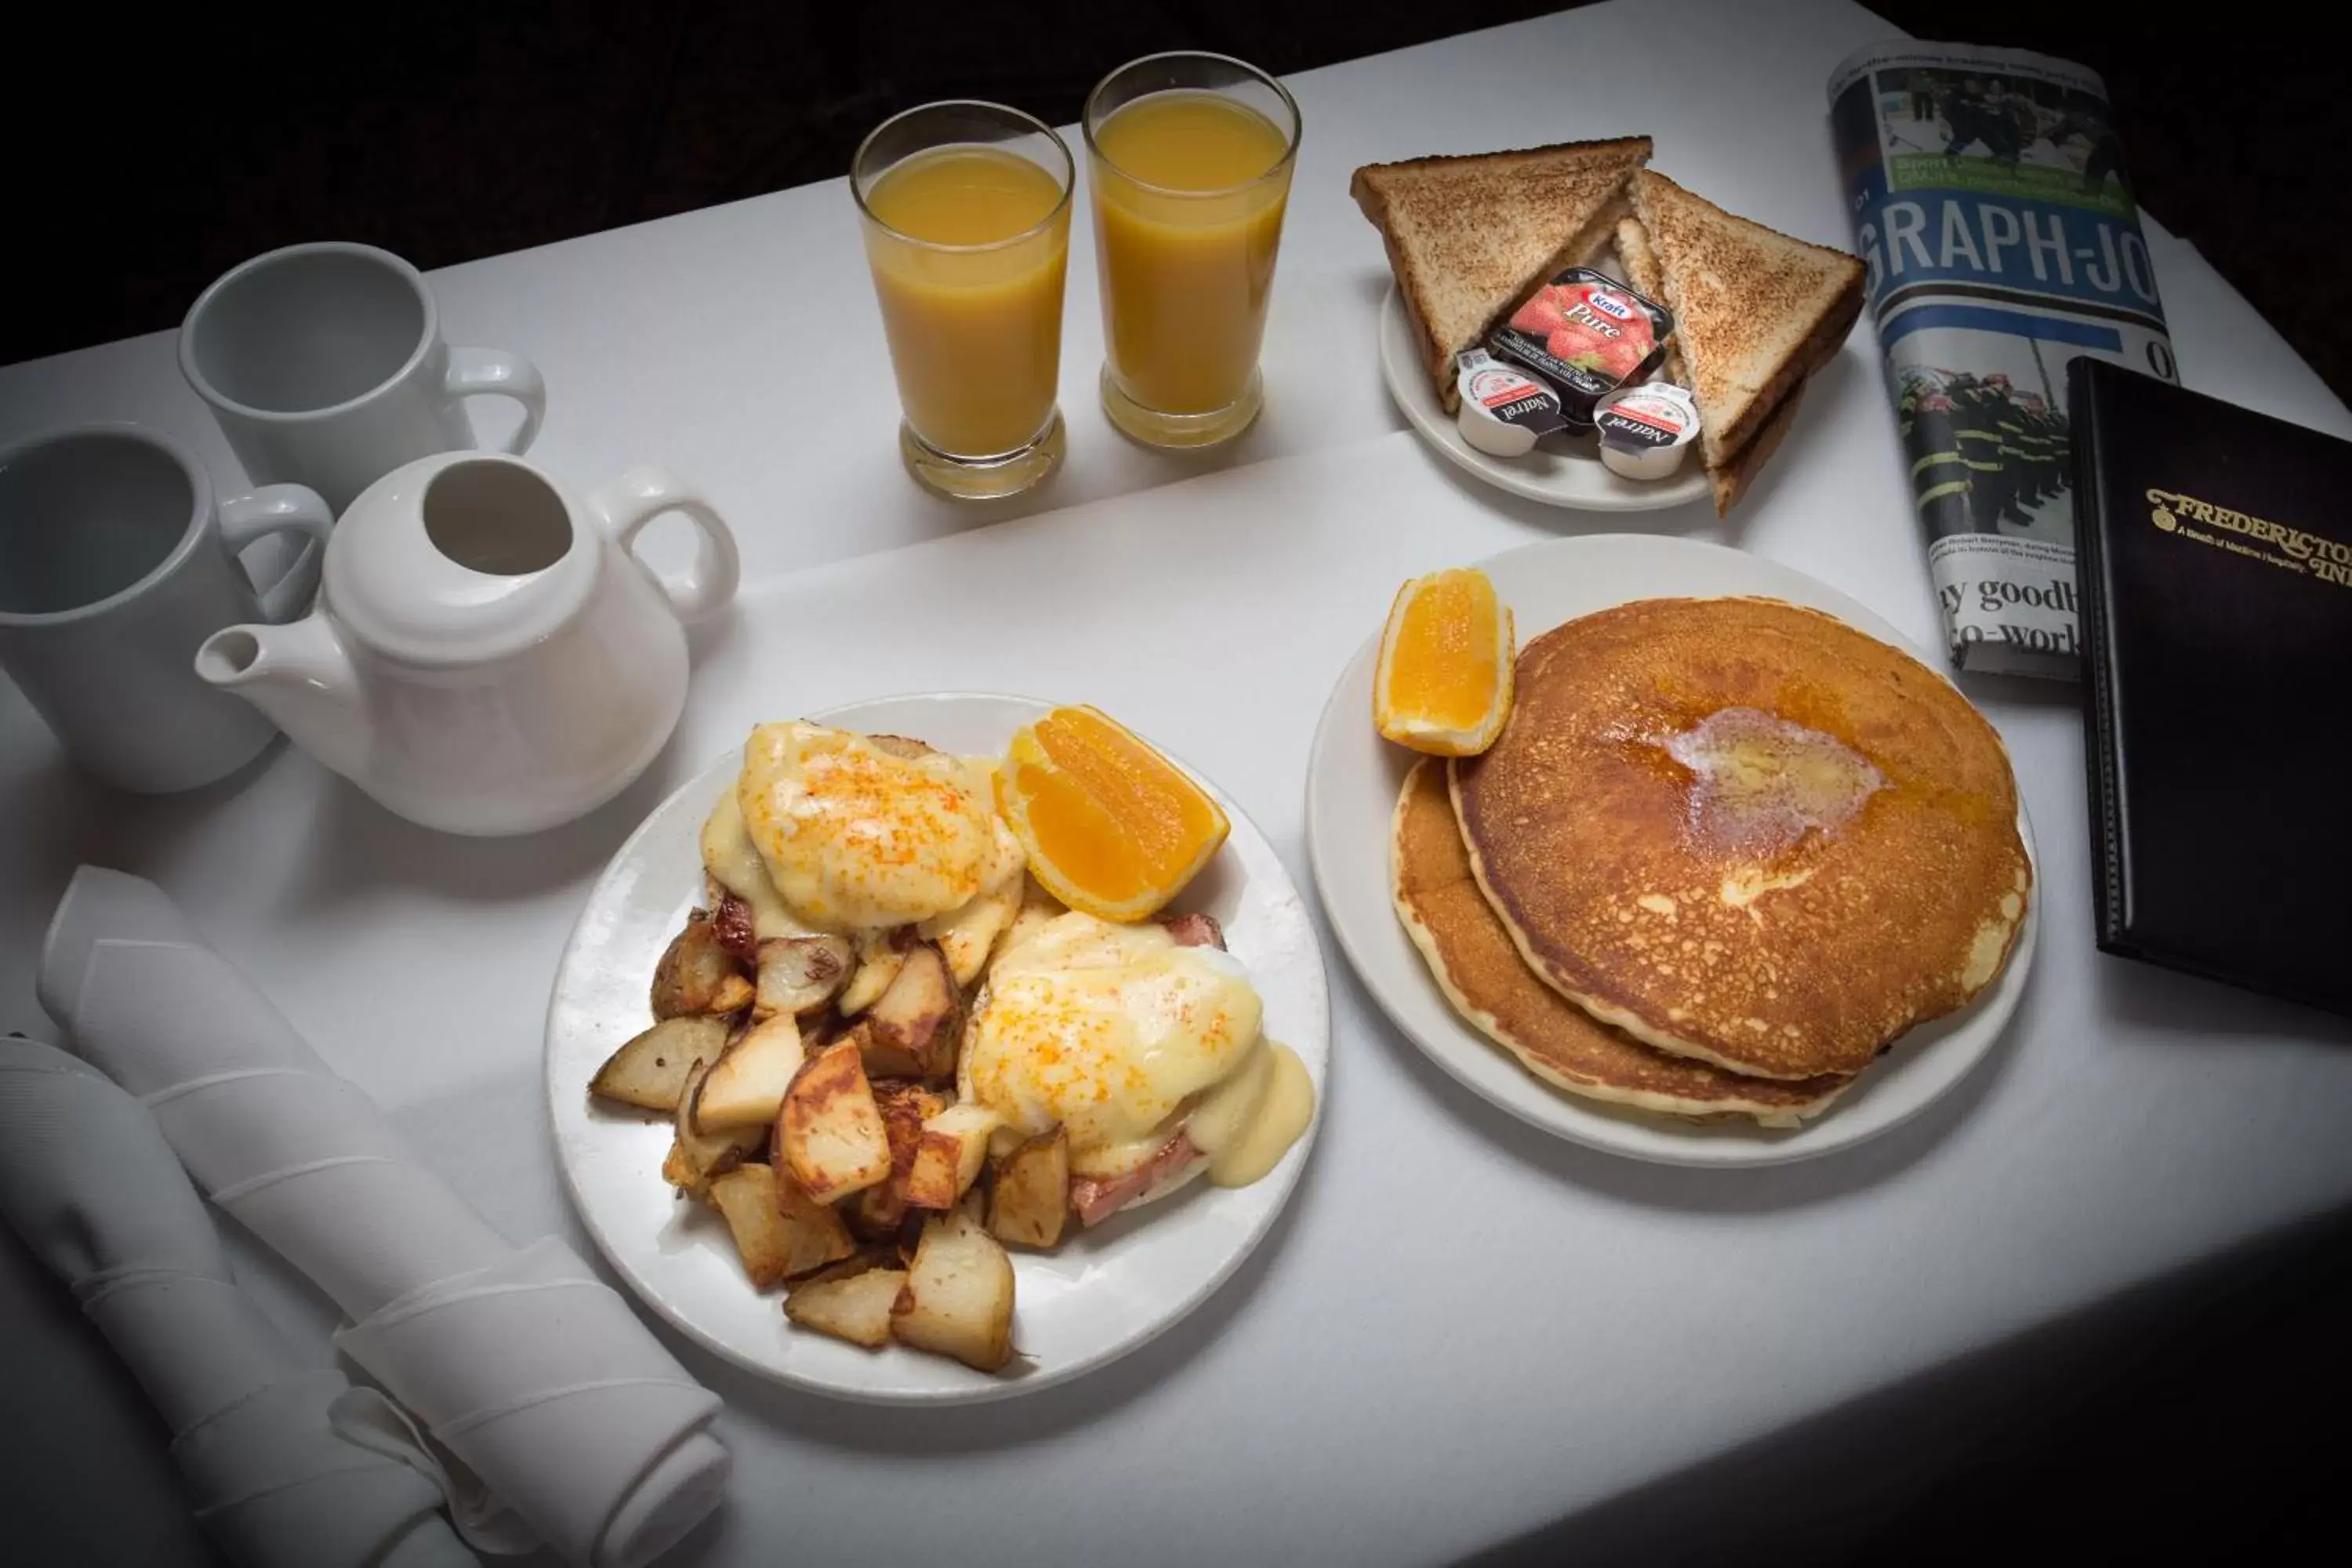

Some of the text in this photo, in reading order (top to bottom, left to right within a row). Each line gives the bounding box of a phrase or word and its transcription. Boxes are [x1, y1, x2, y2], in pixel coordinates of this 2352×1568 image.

[1592, 294, 1628, 317] Kraft
[1565, 302, 1622, 340] Pure
[1502, 395, 1551, 421] Natrel
[1609, 416, 1670, 443] Natrel
